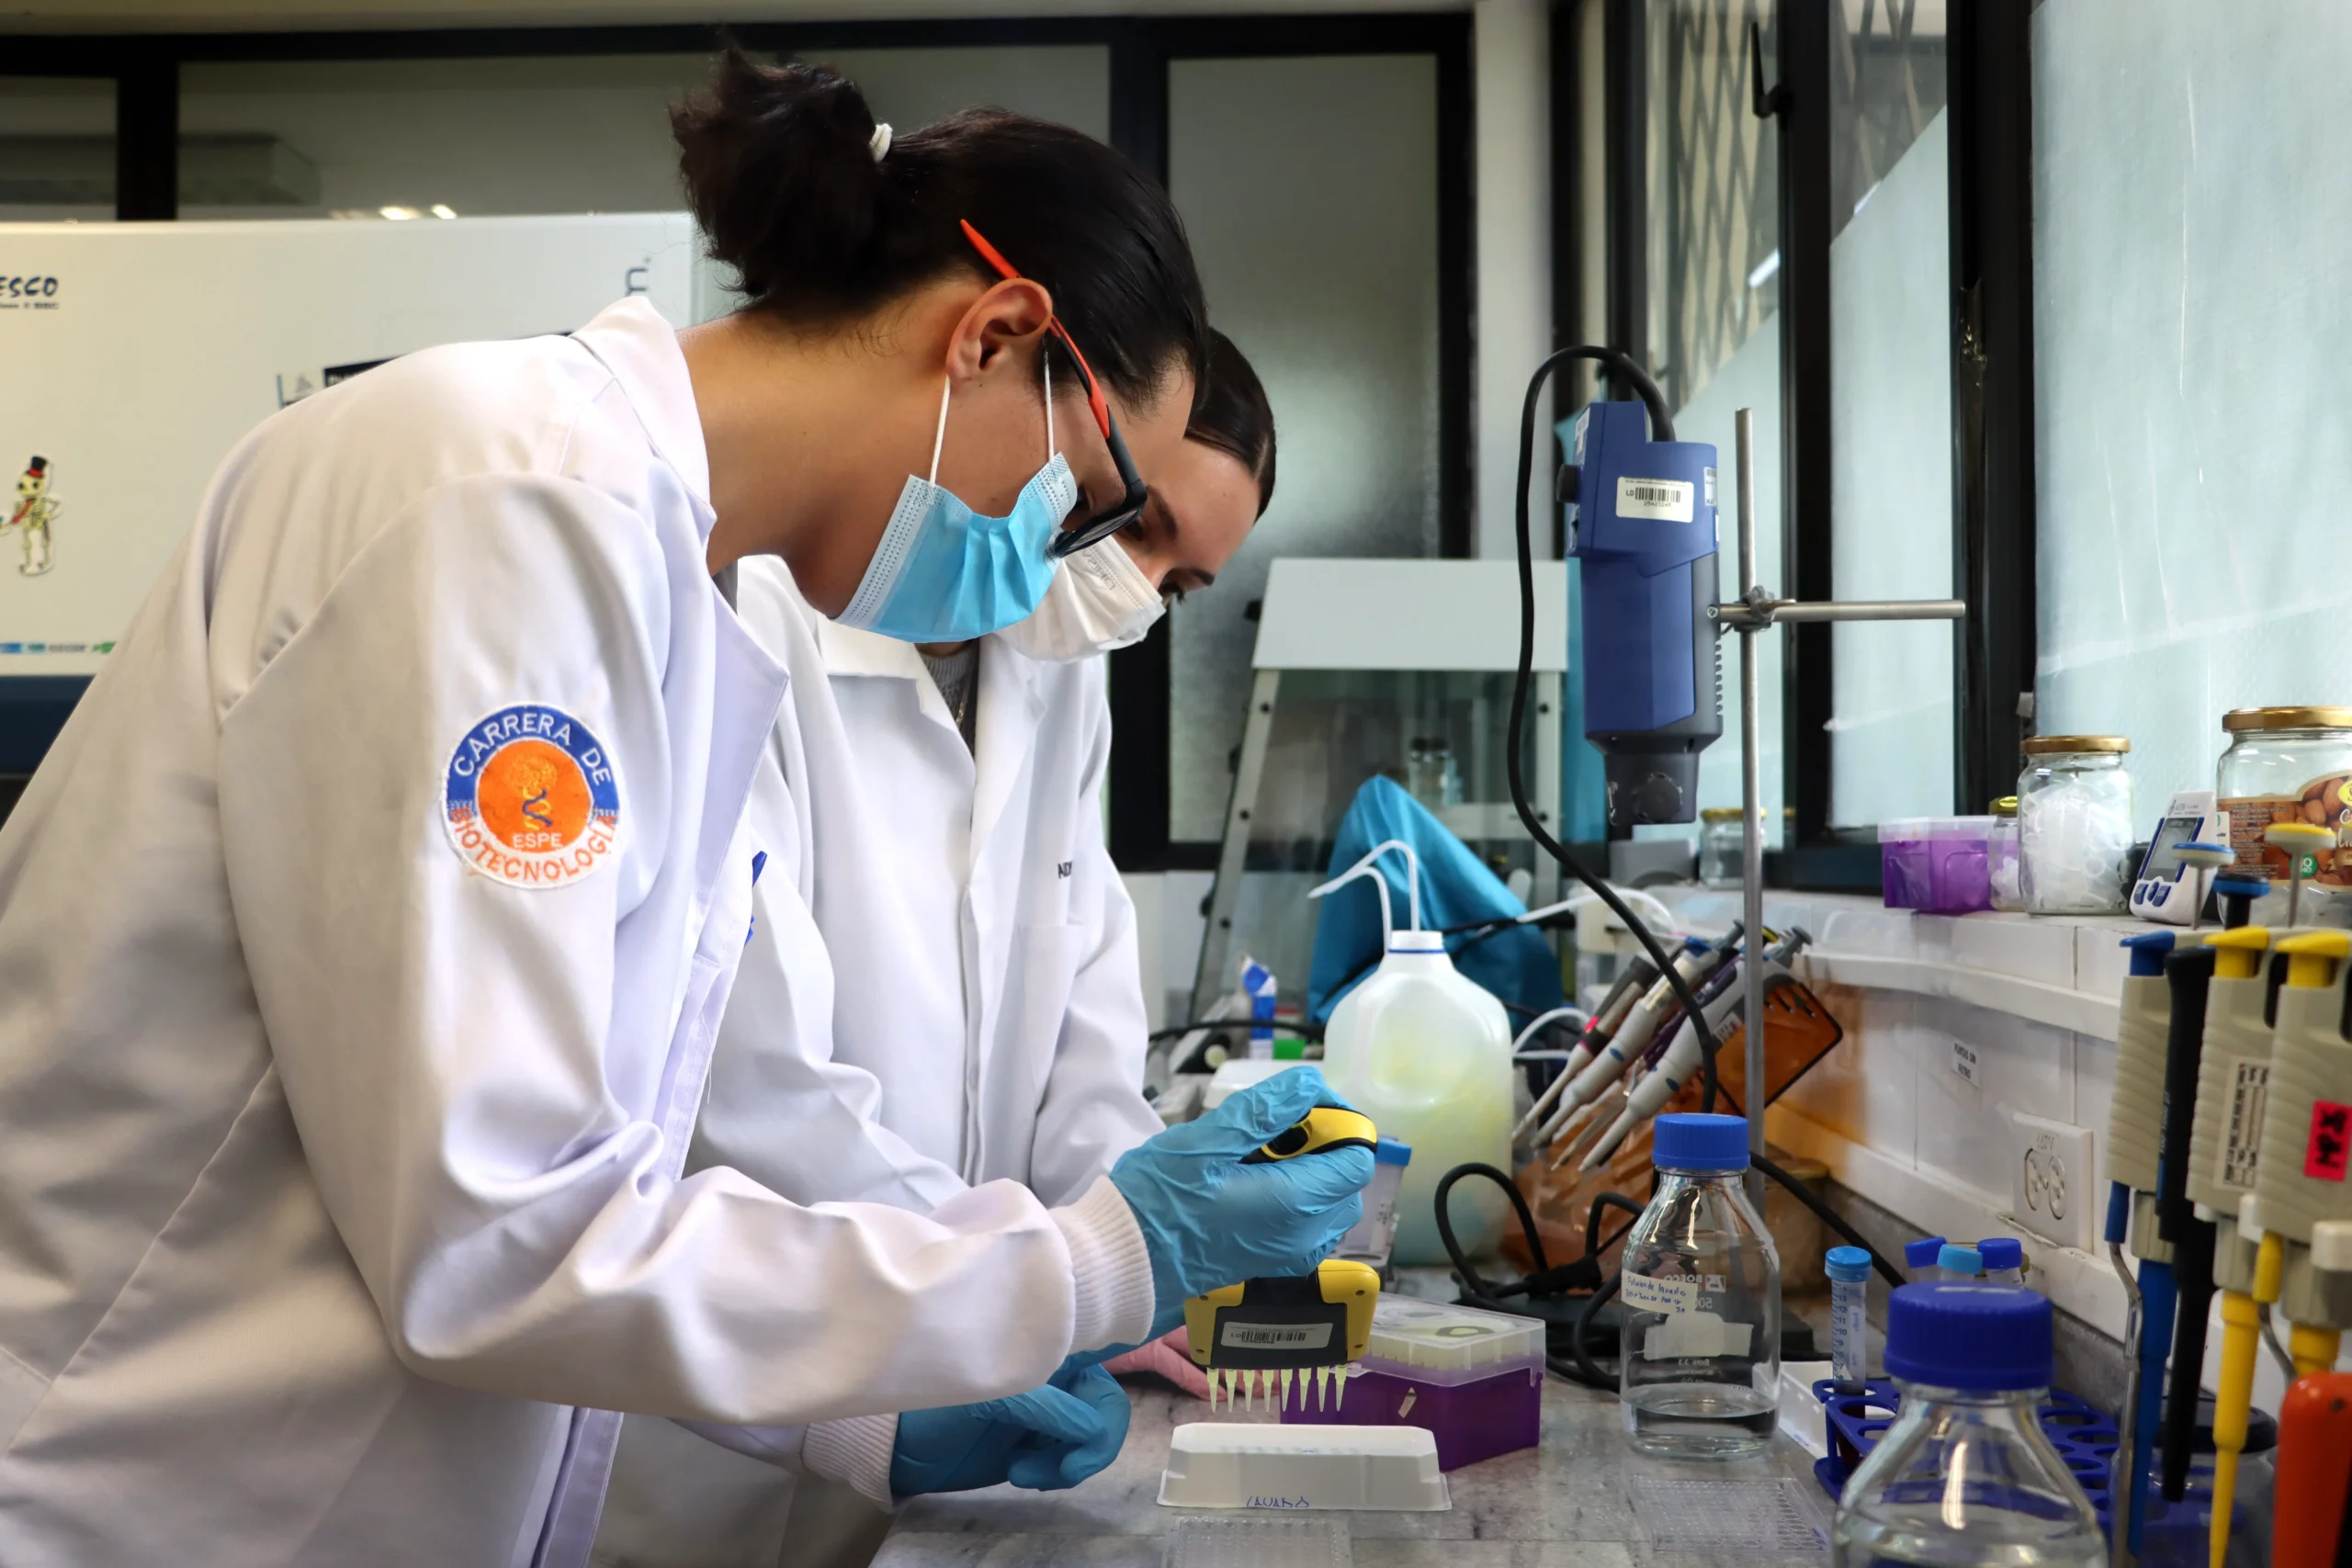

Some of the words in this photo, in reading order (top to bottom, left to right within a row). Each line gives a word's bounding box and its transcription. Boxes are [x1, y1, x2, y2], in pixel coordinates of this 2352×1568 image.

[454, 712, 571, 777] CARRERA
[581, 747, 612, 786] DE
[513, 832, 563, 849] ESPE
